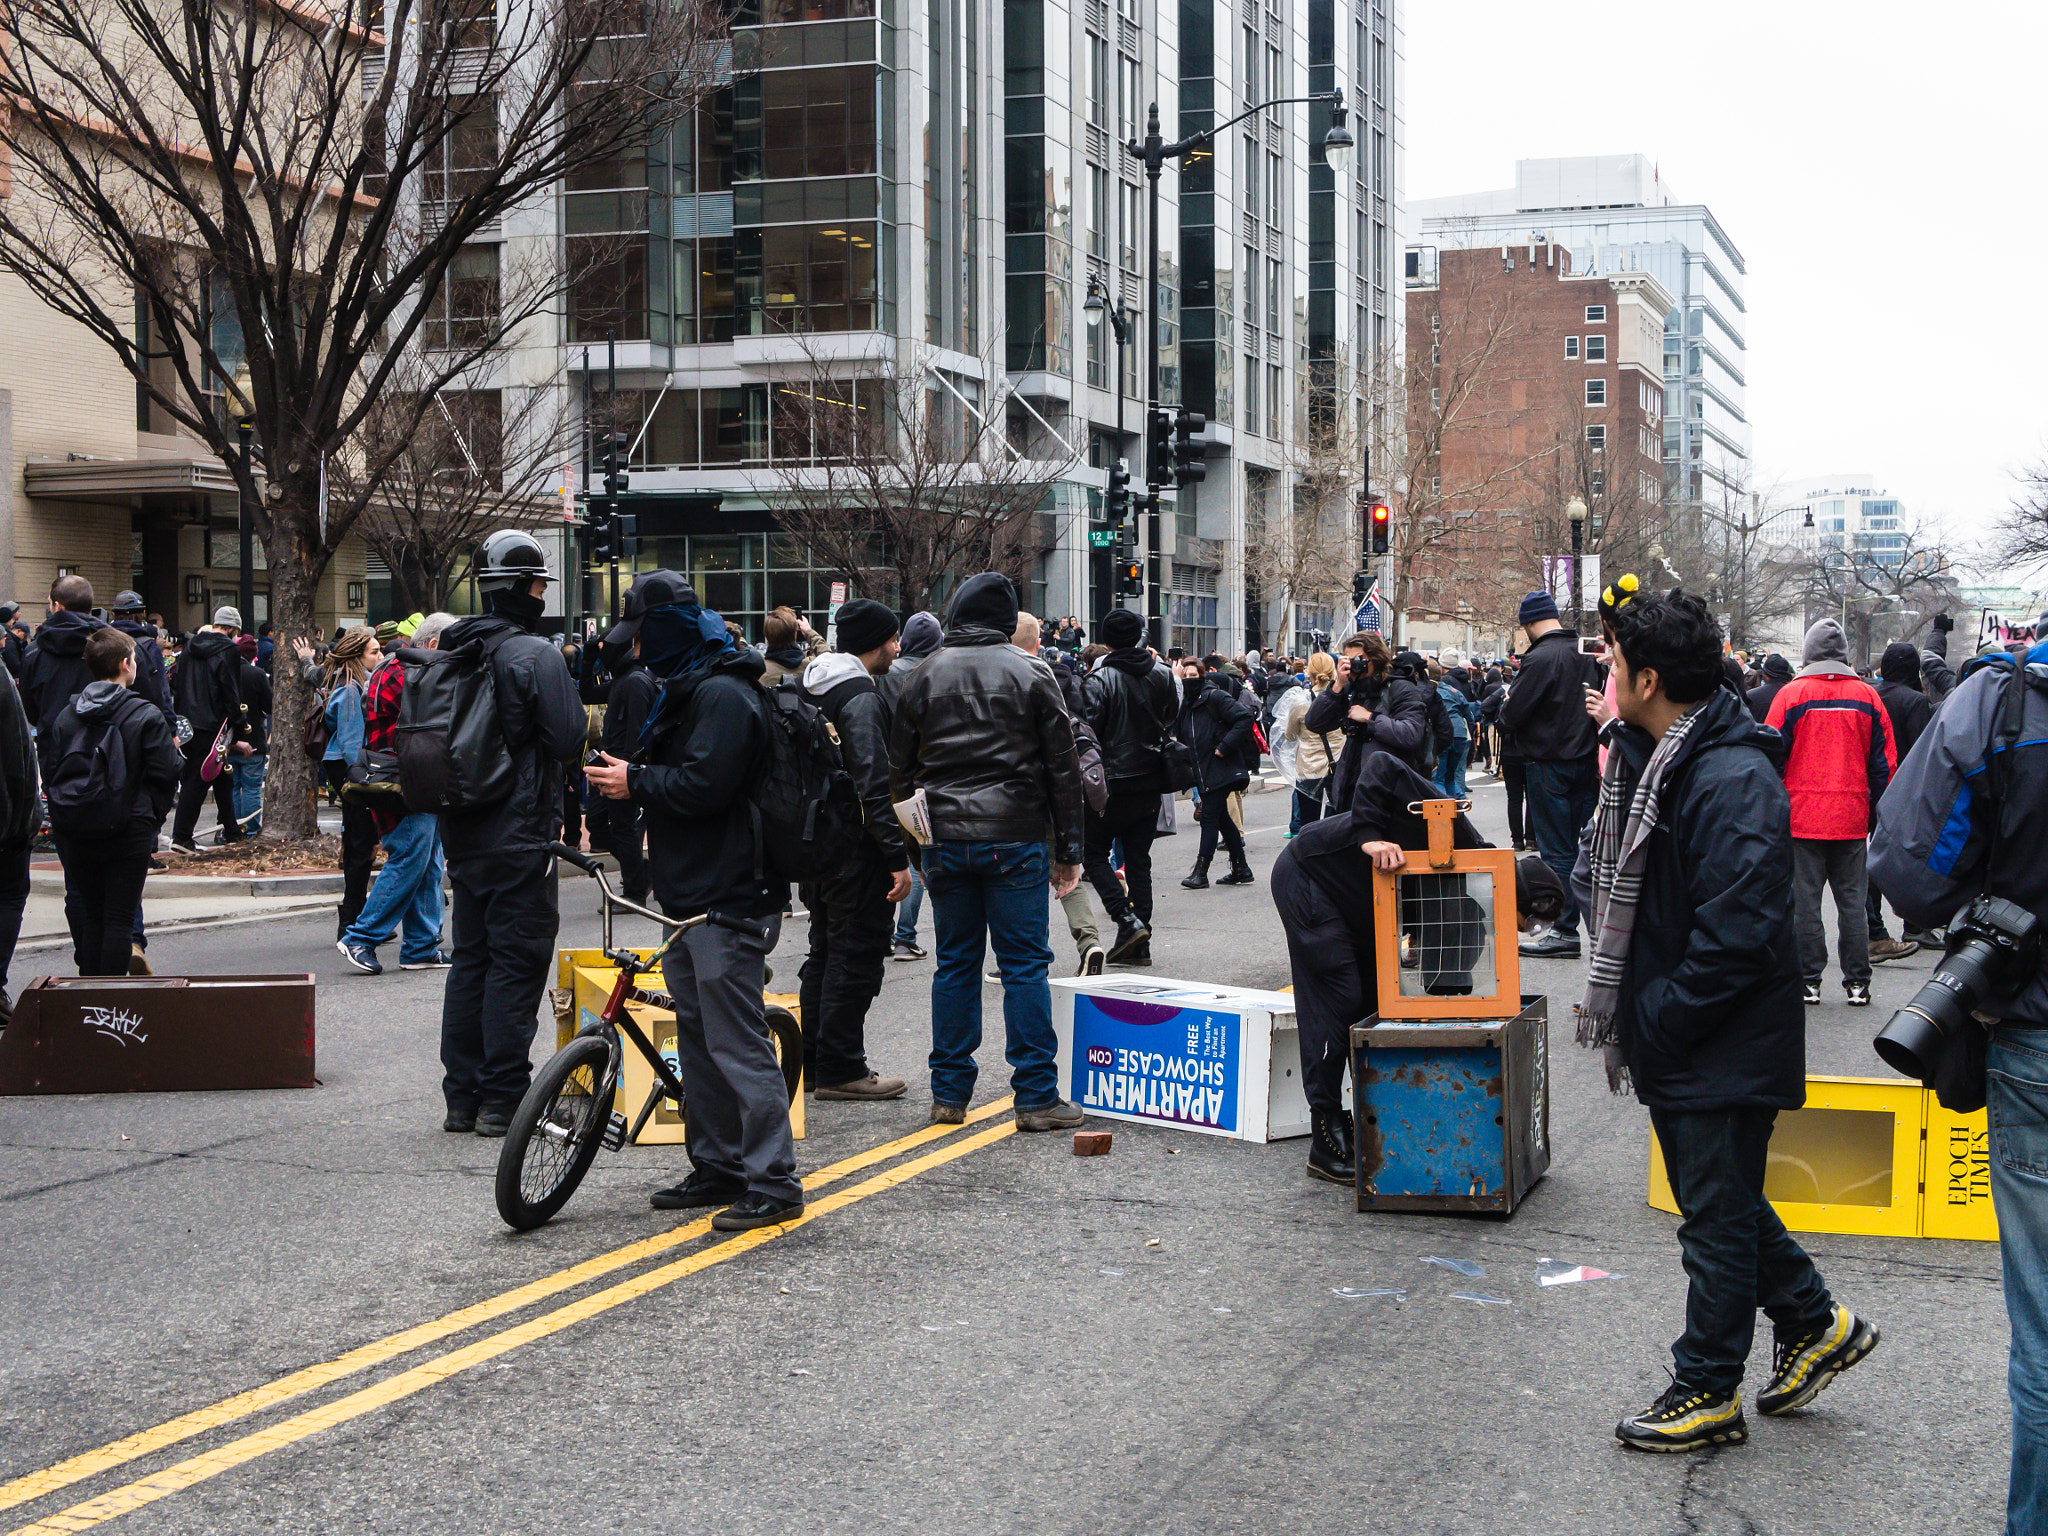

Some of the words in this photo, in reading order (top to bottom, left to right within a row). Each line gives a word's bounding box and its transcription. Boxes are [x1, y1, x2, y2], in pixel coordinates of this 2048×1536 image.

[1091, 532, 1102, 541] 12
[1988, 615, 2000, 641] 4
[182, 718, 194, 736] NOT
[1205, 1016, 1213, 1029] Way
[1213, 1028, 1219, 1036] an
[1187, 1024, 1199, 1055] FREE
[1219, 1026, 1227, 1059] Apartment
[1088, 1049, 1112, 1065] COM
[1083, 1070, 1224, 1125] APARTMENT
[1948, 1126, 1969, 1207] EPOCH
[1970, 1131, 1989, 1203] TIMES
